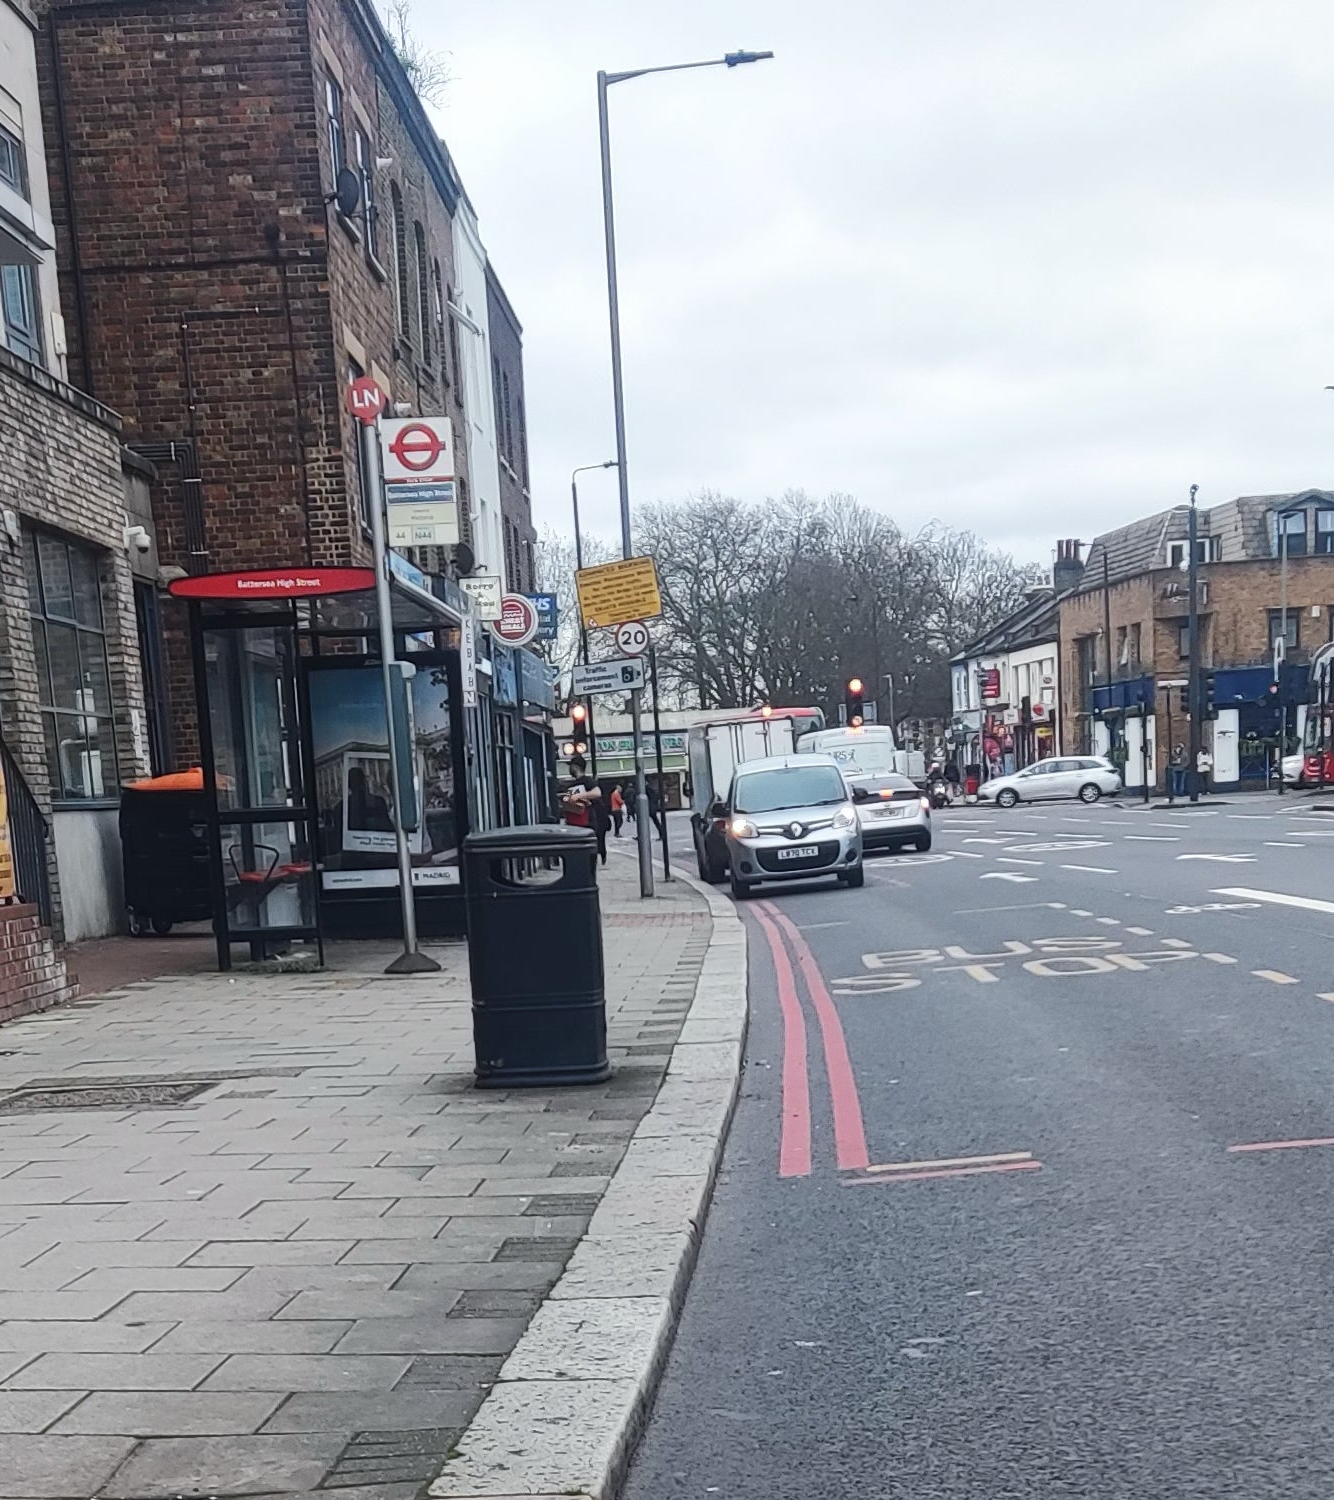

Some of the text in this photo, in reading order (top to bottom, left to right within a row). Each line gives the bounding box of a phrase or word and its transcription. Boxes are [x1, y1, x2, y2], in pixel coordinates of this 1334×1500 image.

[351, 388, 380, 408] LN
[237, 578, 322, 589] Battersea High Street
[621, 630, 646, 645] 20
[585, 665, 608, 675] Traffic
[582, 682, 612, 691] cameras
[861, 936, 1123, 969] BUS
[830, 950, 1200, 995] STOP
